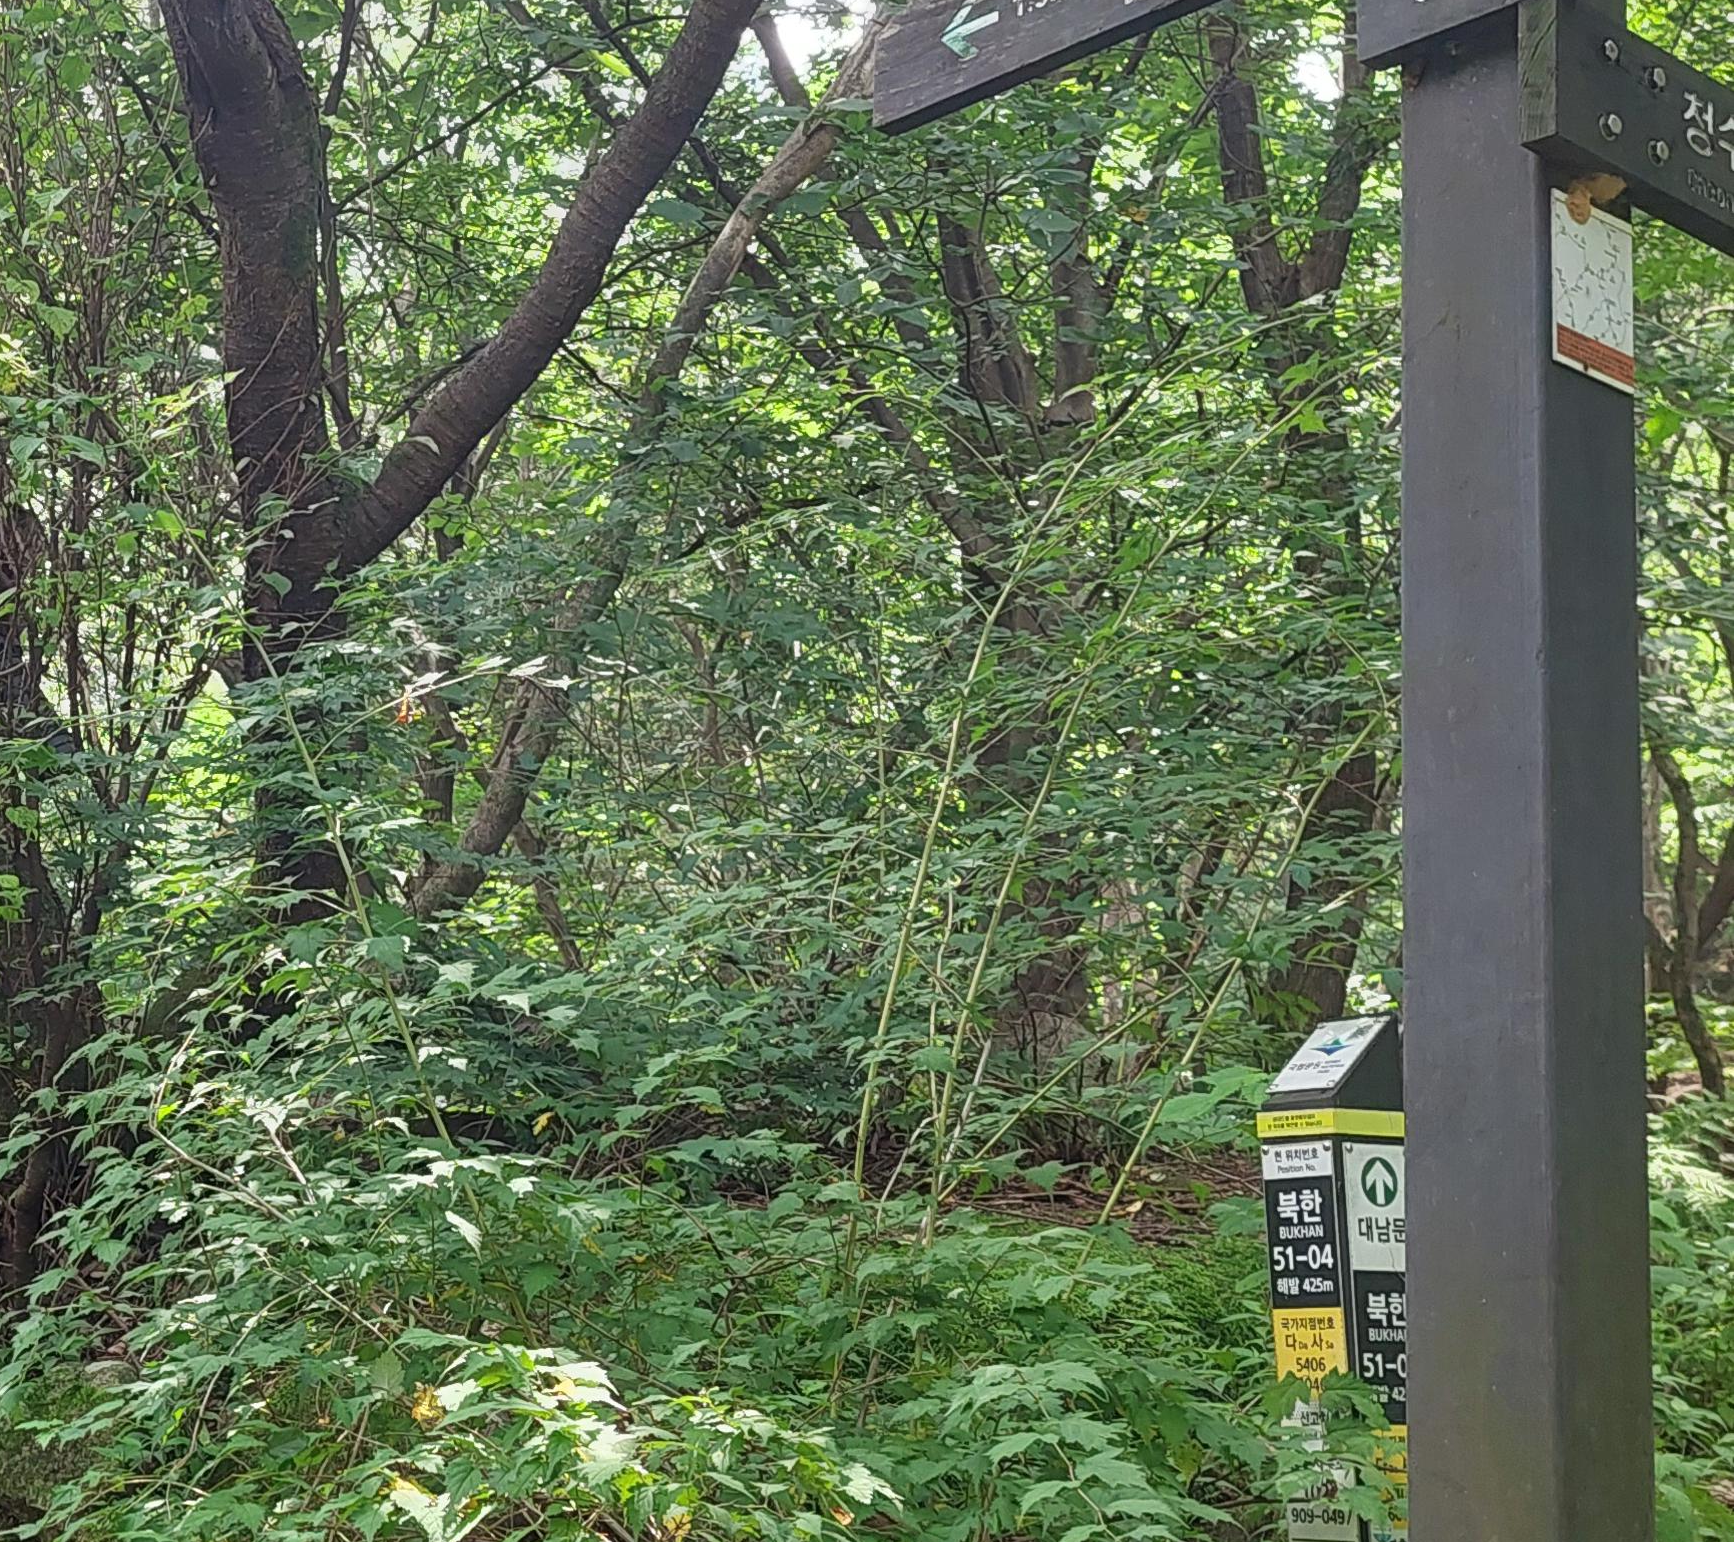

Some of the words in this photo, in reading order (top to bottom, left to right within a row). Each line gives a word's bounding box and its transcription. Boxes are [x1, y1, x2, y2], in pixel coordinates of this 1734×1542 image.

[1274, 1149, 1282, 1163] 현
[1286, 1147, 1319, 1161] 위치번호
[1277, 1164, 1303, 1174] Position
[1305, 1163, 1317, 1172] No.
[1277, 1189, 1323, 1224] 북한
[1279, 1225, 1324, 1239] BUKHAN
[1357, 1216, 1406, 1244] 대남문
[1273, 1243, 1333, 1271] 51-04
[1277, 1277, 1300, 1295] 해발
[1303, 1277, 1334, 1293] 425m
[1367, 1292, 1406, 1327] 북한
[1281, 1317, 1336, 1331] 국가지점번호
[1285, 1333, 1297, 1351] 다
[1311, 1332, 1323, 1349] 사
[1296, 1356, 1326, 1372] 5406
